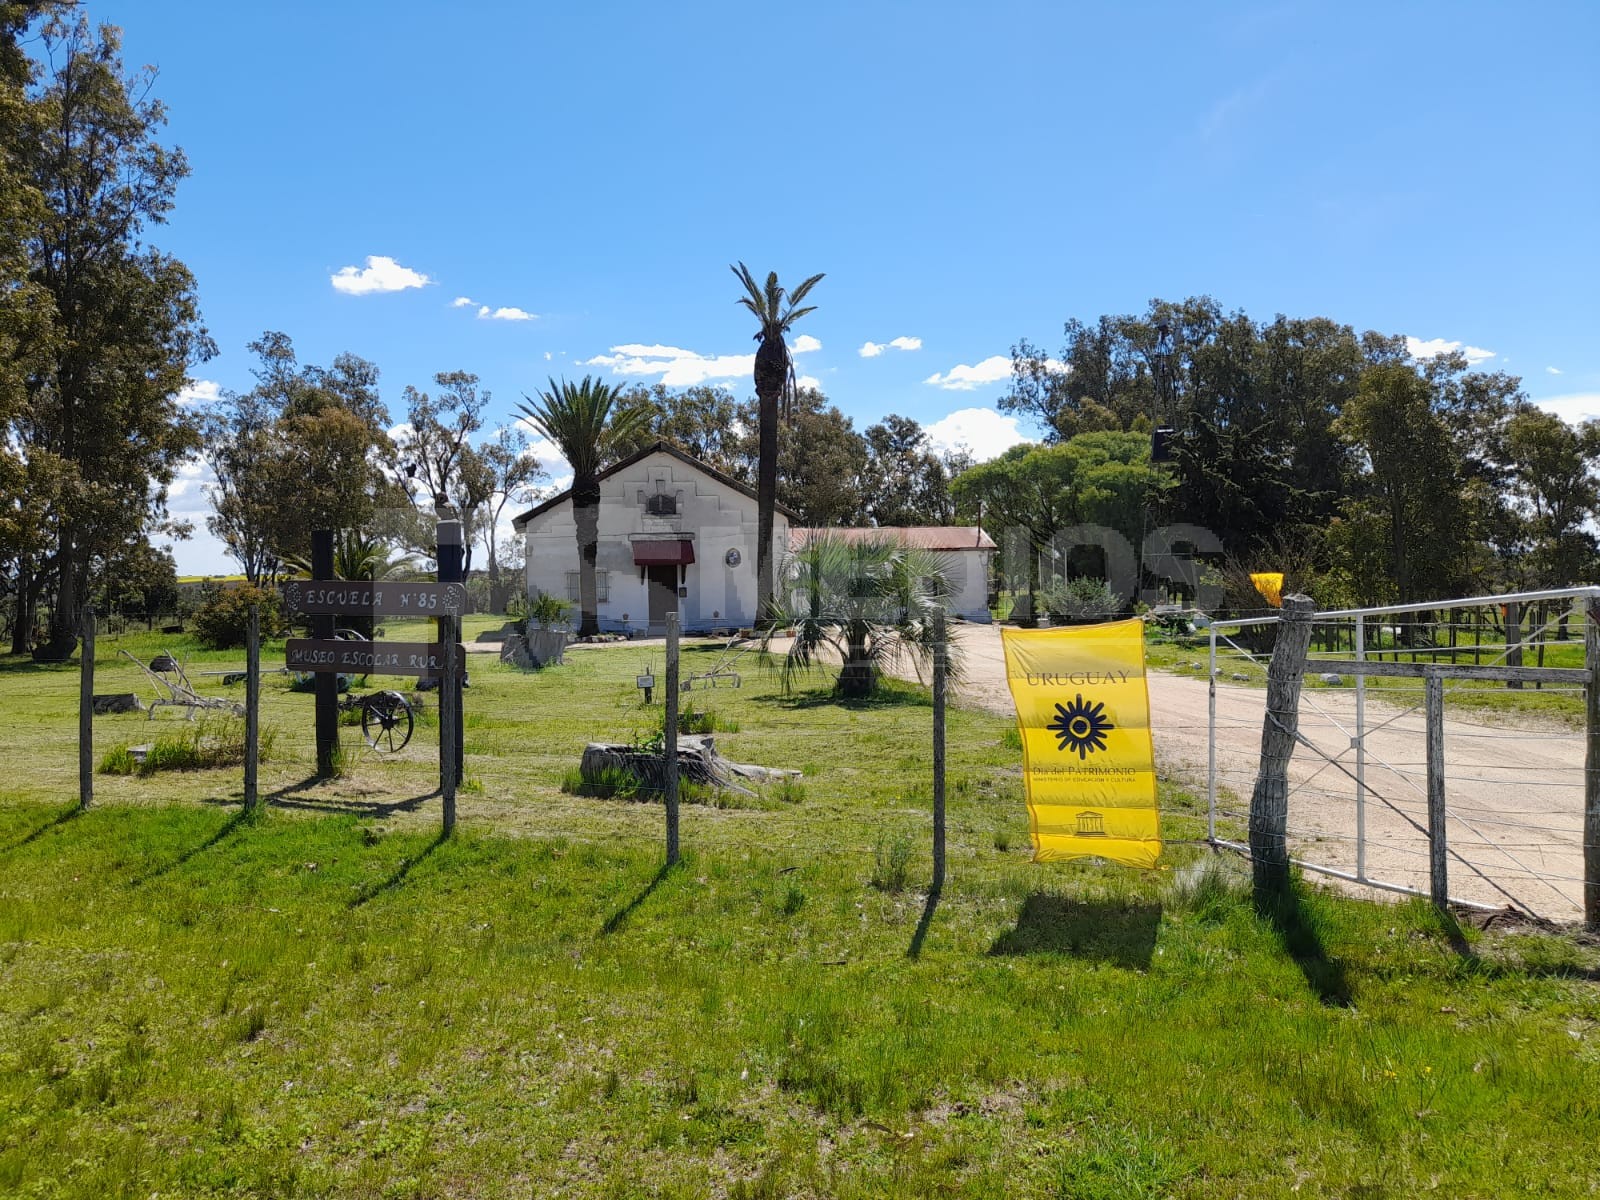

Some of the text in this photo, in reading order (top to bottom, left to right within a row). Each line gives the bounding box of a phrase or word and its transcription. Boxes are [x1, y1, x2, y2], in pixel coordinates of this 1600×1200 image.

[306, 588, 383, 606] ESCUELA
[291, 648, 335, 664] MUSEO
[342, 651, 401, 667] ESCOLAR
[1026, 669, 1130, 686] URUGUAY
[1068, 766, 1136, 776] PATRIMONIO
